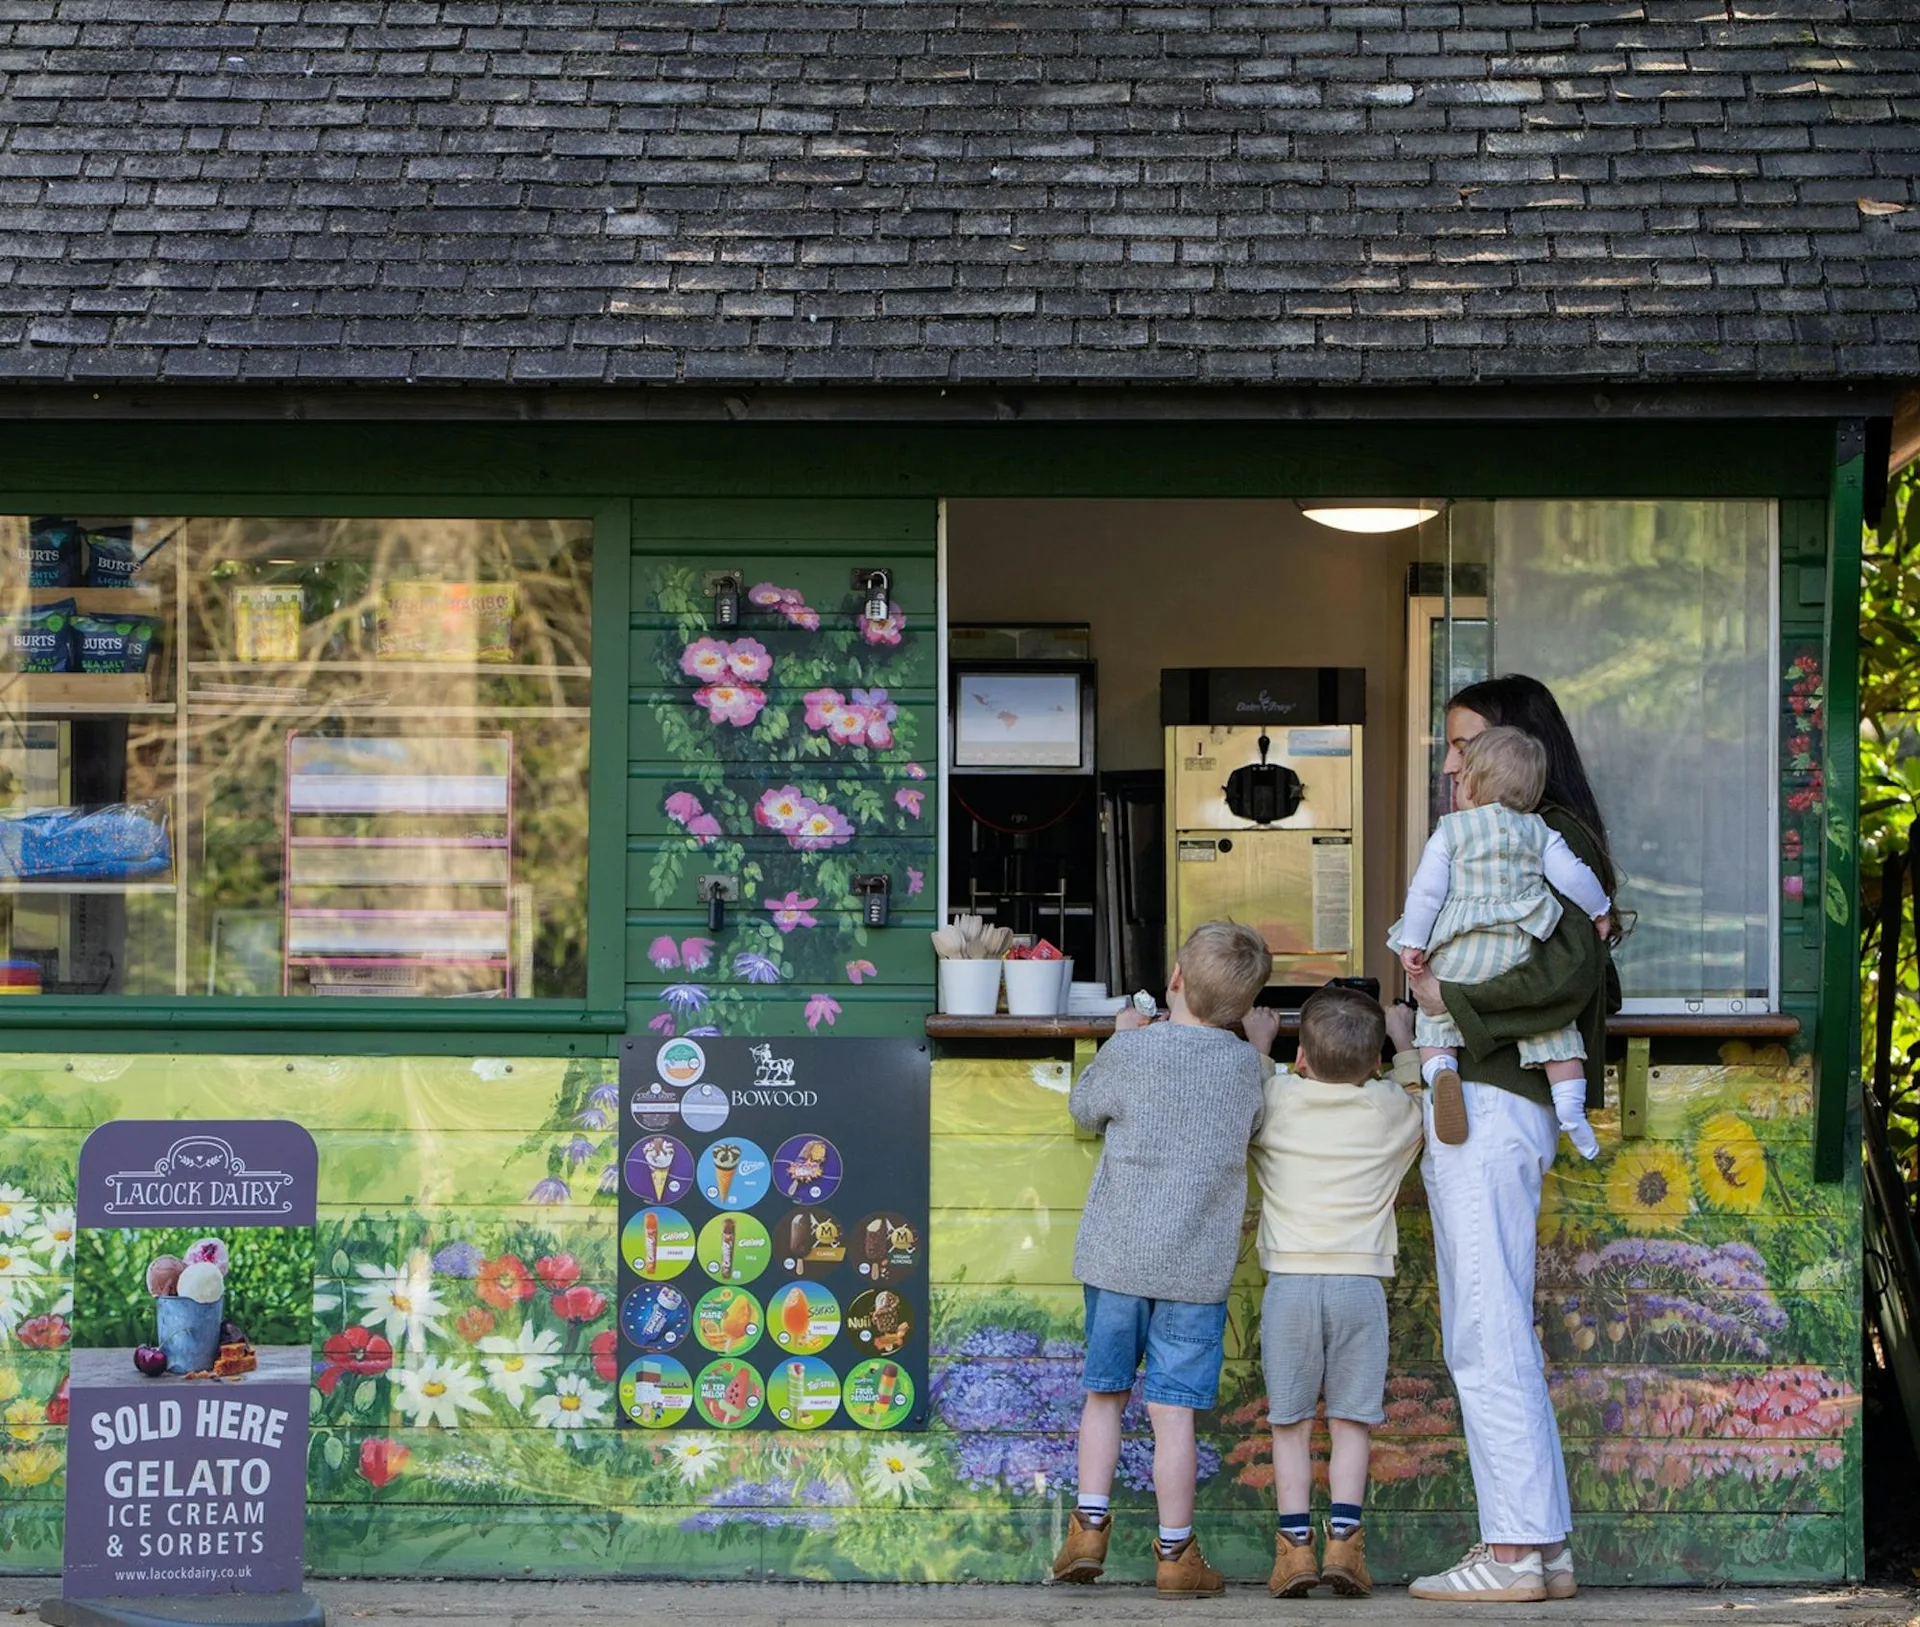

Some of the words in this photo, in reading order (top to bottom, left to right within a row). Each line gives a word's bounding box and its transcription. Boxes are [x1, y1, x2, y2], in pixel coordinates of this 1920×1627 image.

[19, 549, 60, 562] BURTS
[97, 556, 142, 573] BURTS
[13, 634, 56, 648] BURTS
[82, 637, 123, 650] BURTS
[731, 1090, 818, 1107] BOWOOD
[114, 1182, 205, 1206] LACOCK
[209, 1181, 283, 1206] DAIRY
[90, 1399, 183, 1452] SOLD
[195, 1399, 289, 1449] HERE
[104, 1458, 271, 1499] GELATO
[108, 1503, 152, 1528] ICE
[167, 1501, 265, 1526] CREAM
[106, 1534, 124, 1558] &
[139, 1531, 264, 1557] SORBETS
[115, 1565, 253, 1582] www.lacockdairy.co.uk
